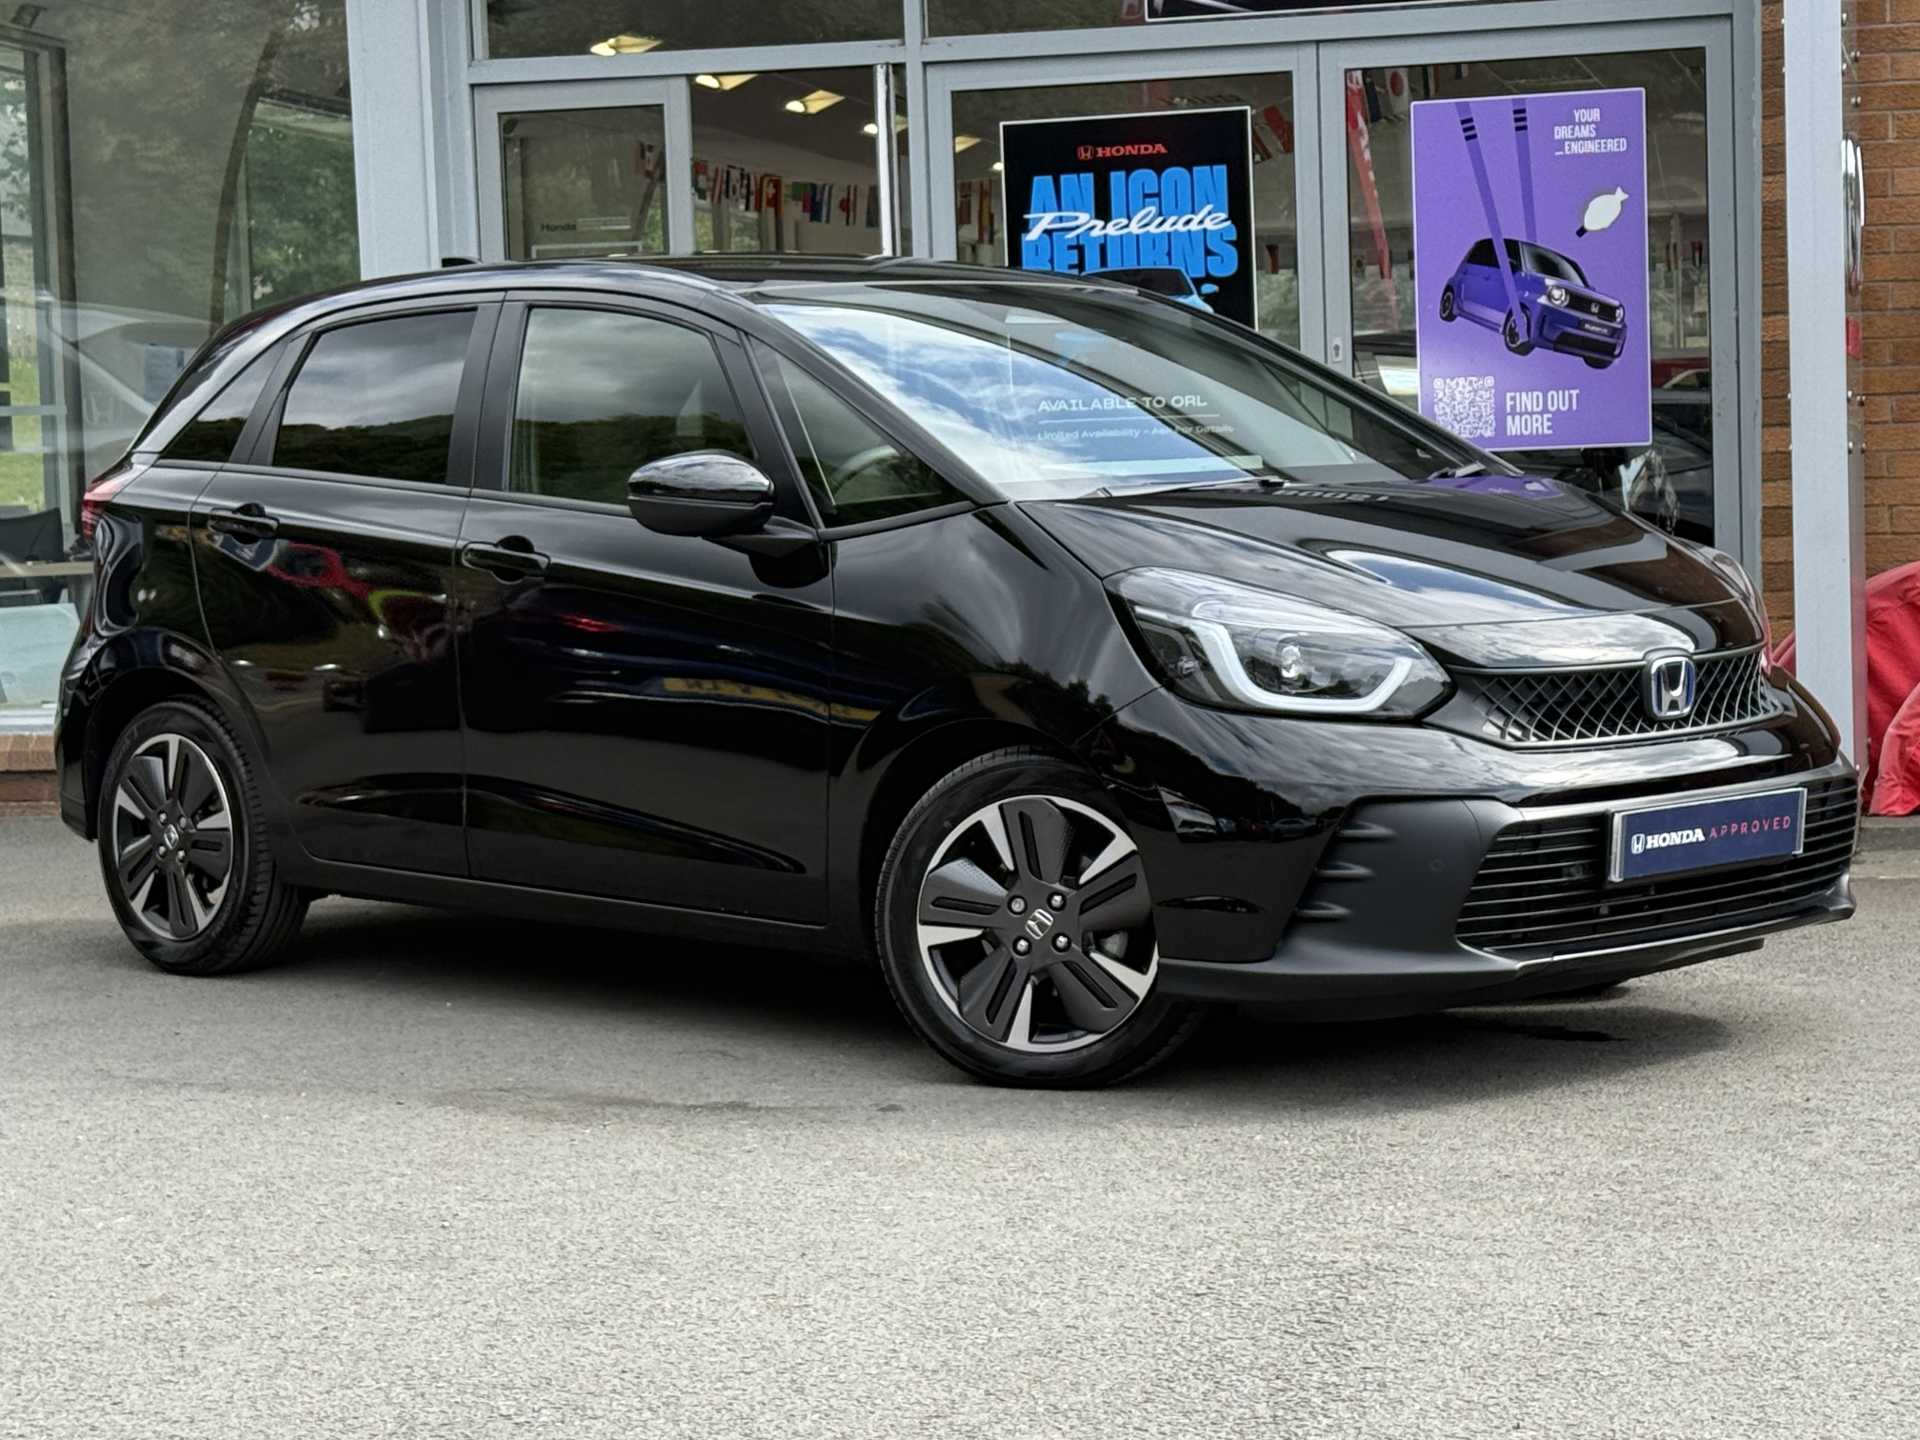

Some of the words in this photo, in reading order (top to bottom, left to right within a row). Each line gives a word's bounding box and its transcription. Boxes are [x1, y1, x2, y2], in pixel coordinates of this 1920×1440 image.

[1573, 108, 1600, 123] YOUR
[1554, 124, 1596, 139] DREAMS
[1096, 144, 1168, 157] HONDA
[1029, 173, 1095, 229] AN
[1110, 164, 1228, 222] ICON
[1023, 204, 1231, 240] Prelude
[1021, 224, 1238, 278] RETURNS
[1038, 397, 1137, 412] AVAILABLE
[1143, 396, 1166, 408] TO
[1506, 391, 1543, 413] FIND
[1547, 389, 1580, 411] OUT
[1506, 414, 1553, 436] MORE
[1645, 828, 1705, 849] HONDA
[1709, 815, 1792, 839] APPROVED
